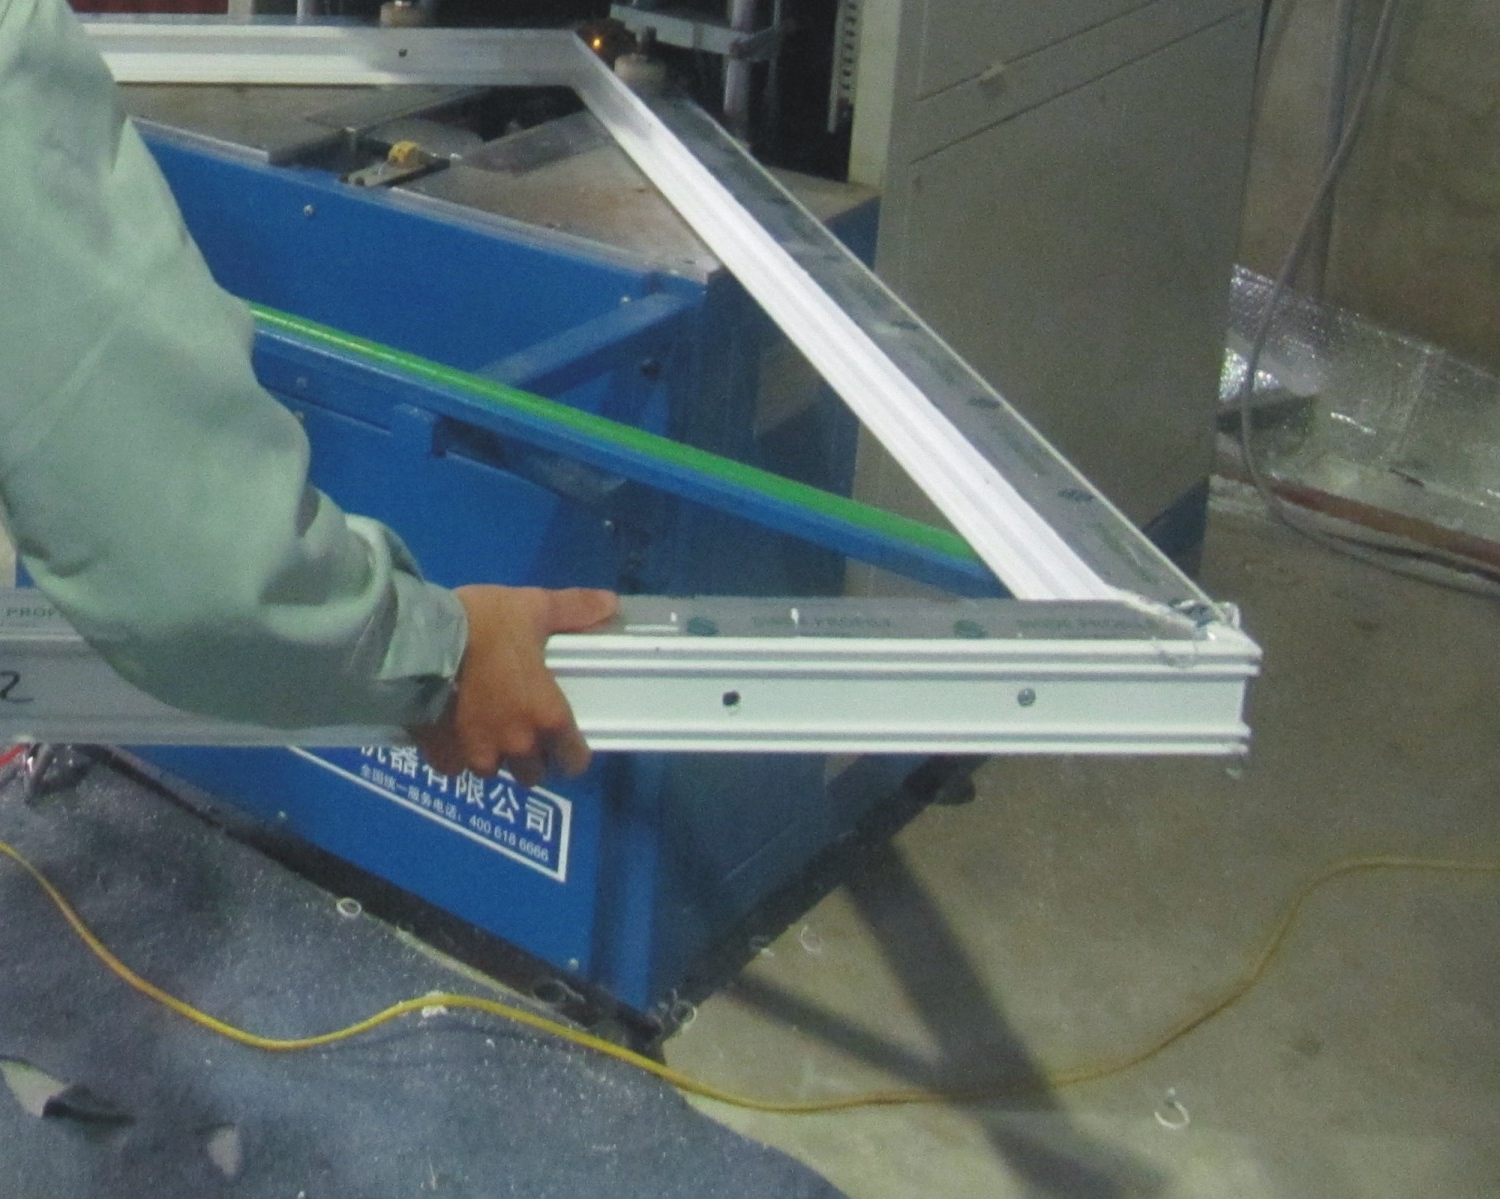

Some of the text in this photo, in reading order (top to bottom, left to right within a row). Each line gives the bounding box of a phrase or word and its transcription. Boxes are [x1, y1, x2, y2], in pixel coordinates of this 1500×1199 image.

[469, 813, 492, 835] 400
[493, 827, 517, 847] 618
[518, 838, 550, 863] 6666
